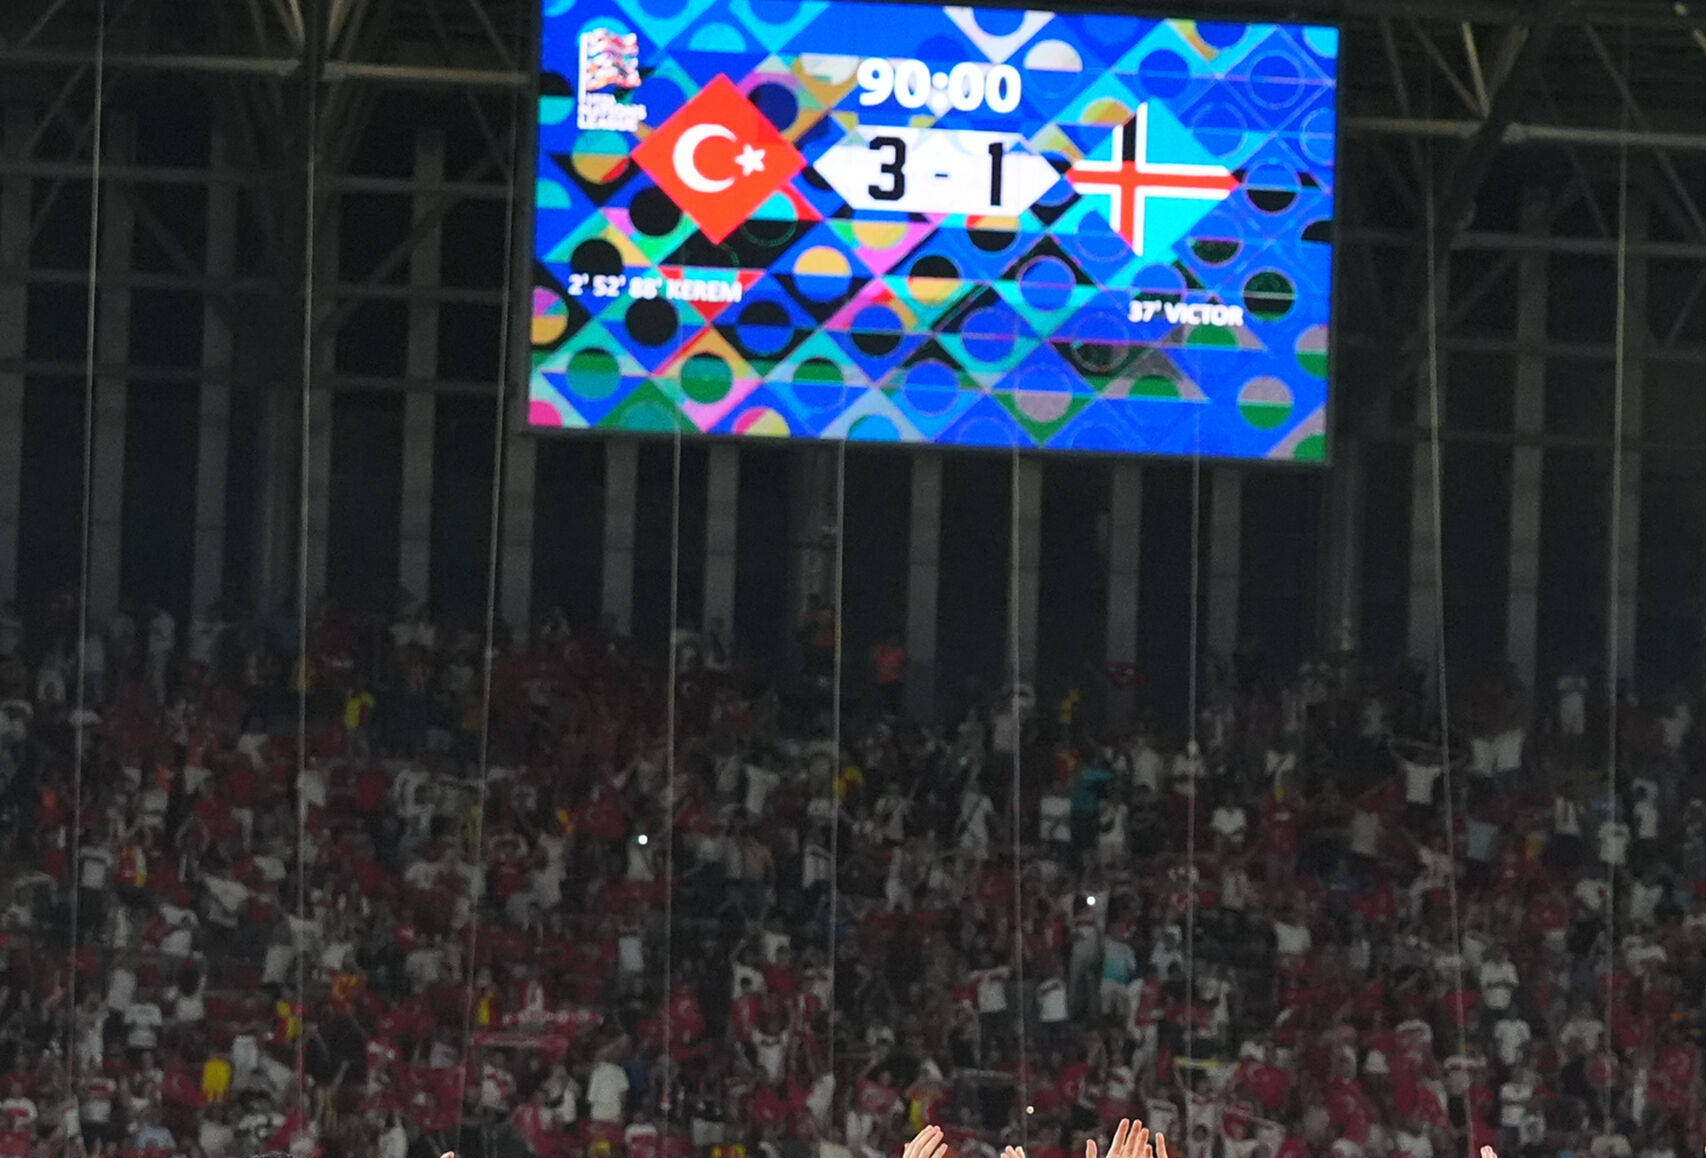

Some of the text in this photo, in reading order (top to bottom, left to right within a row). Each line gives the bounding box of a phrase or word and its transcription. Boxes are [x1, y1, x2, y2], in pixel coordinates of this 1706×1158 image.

[857, 57, 1021, 113] 90:00
[868, 136, 906, 201] 3
[988, 142, 1004, 206] 1
[666, 278, 743, 302] KEREM
[1164, 302, 1244, 327] VICTOR
